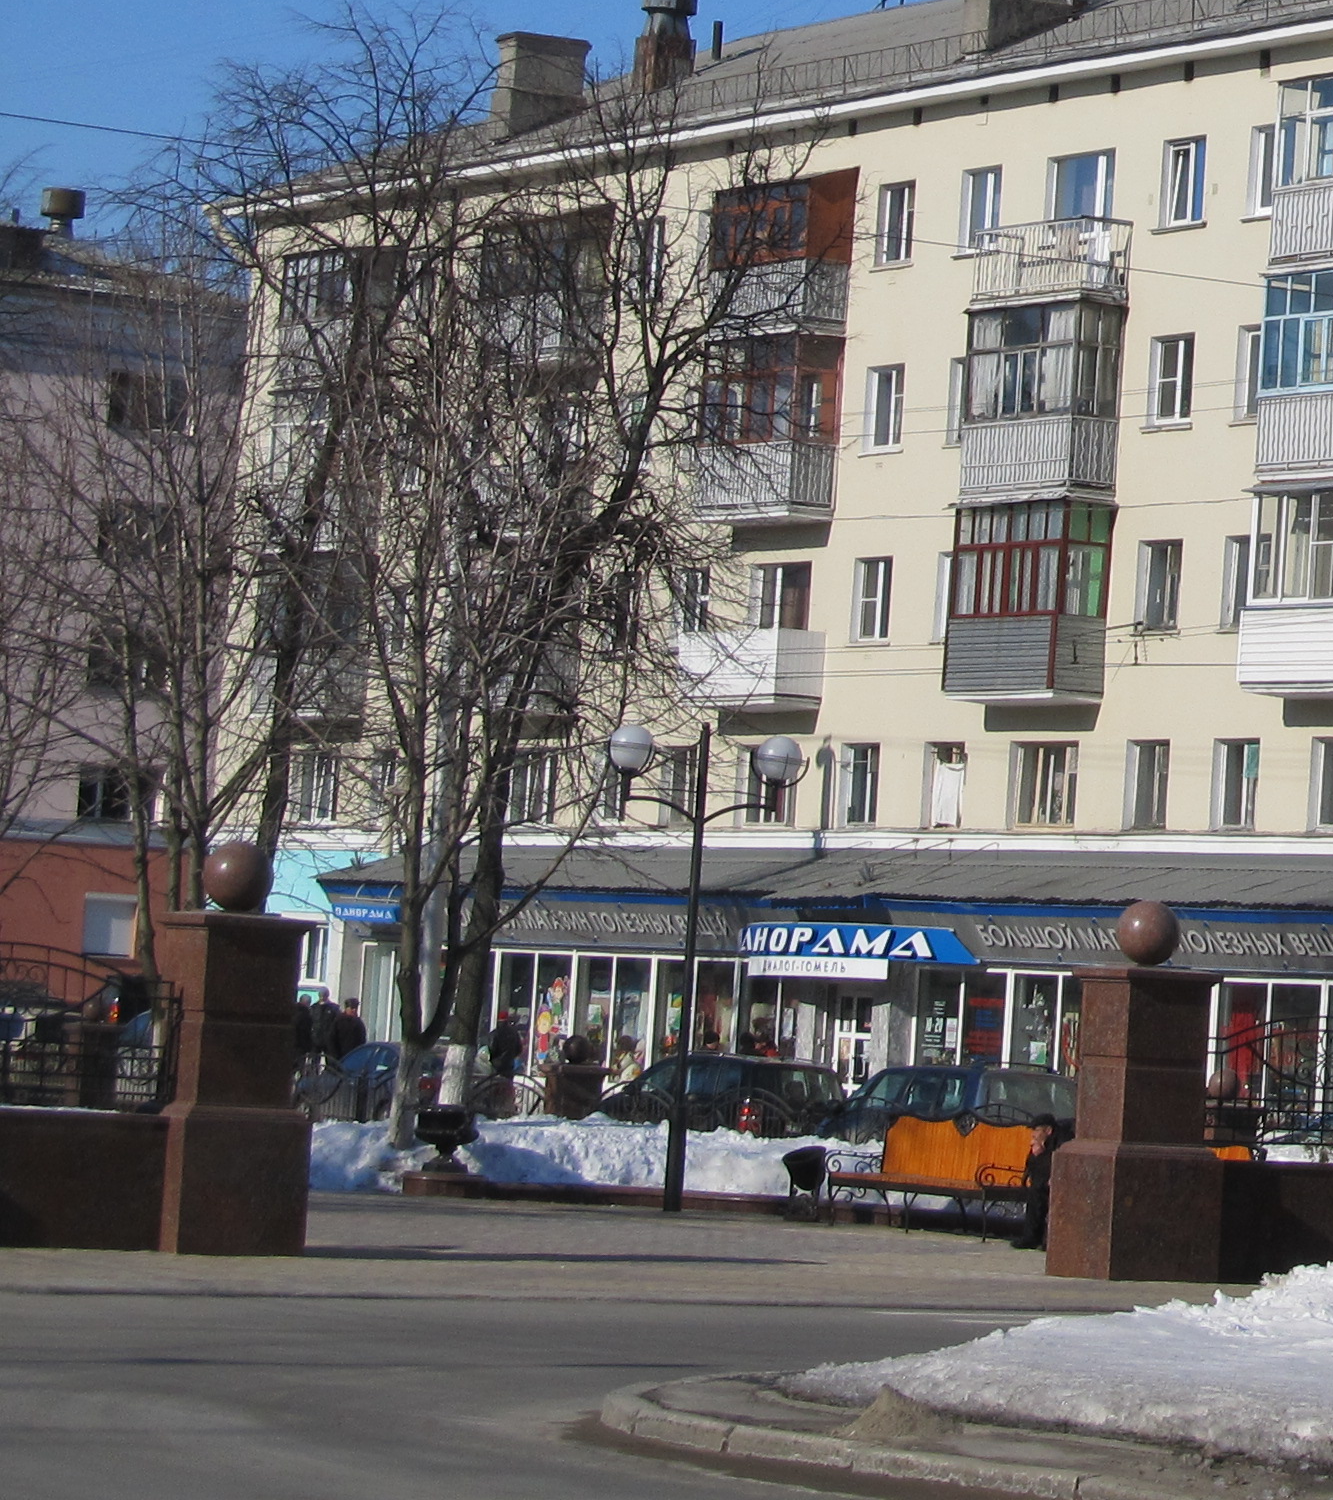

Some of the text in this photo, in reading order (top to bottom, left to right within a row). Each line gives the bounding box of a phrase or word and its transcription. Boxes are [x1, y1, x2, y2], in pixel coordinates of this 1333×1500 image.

[335, 906, 393, 920] ПАНОРАМА
[518, 908, 588, 932] МАГАЗИН
[589, 910, 675, 936] ПОЛЕЗНЫХ
[675, 911, 730, 940] ВЩЕЙ
[739, 927, 933, 959] АНОРАМА
[975, 923, 1079, 951] БОЛЬШОЙ
[762, 959, 847, 974] ДИАЛОГ-ГОМЕЛЬ
